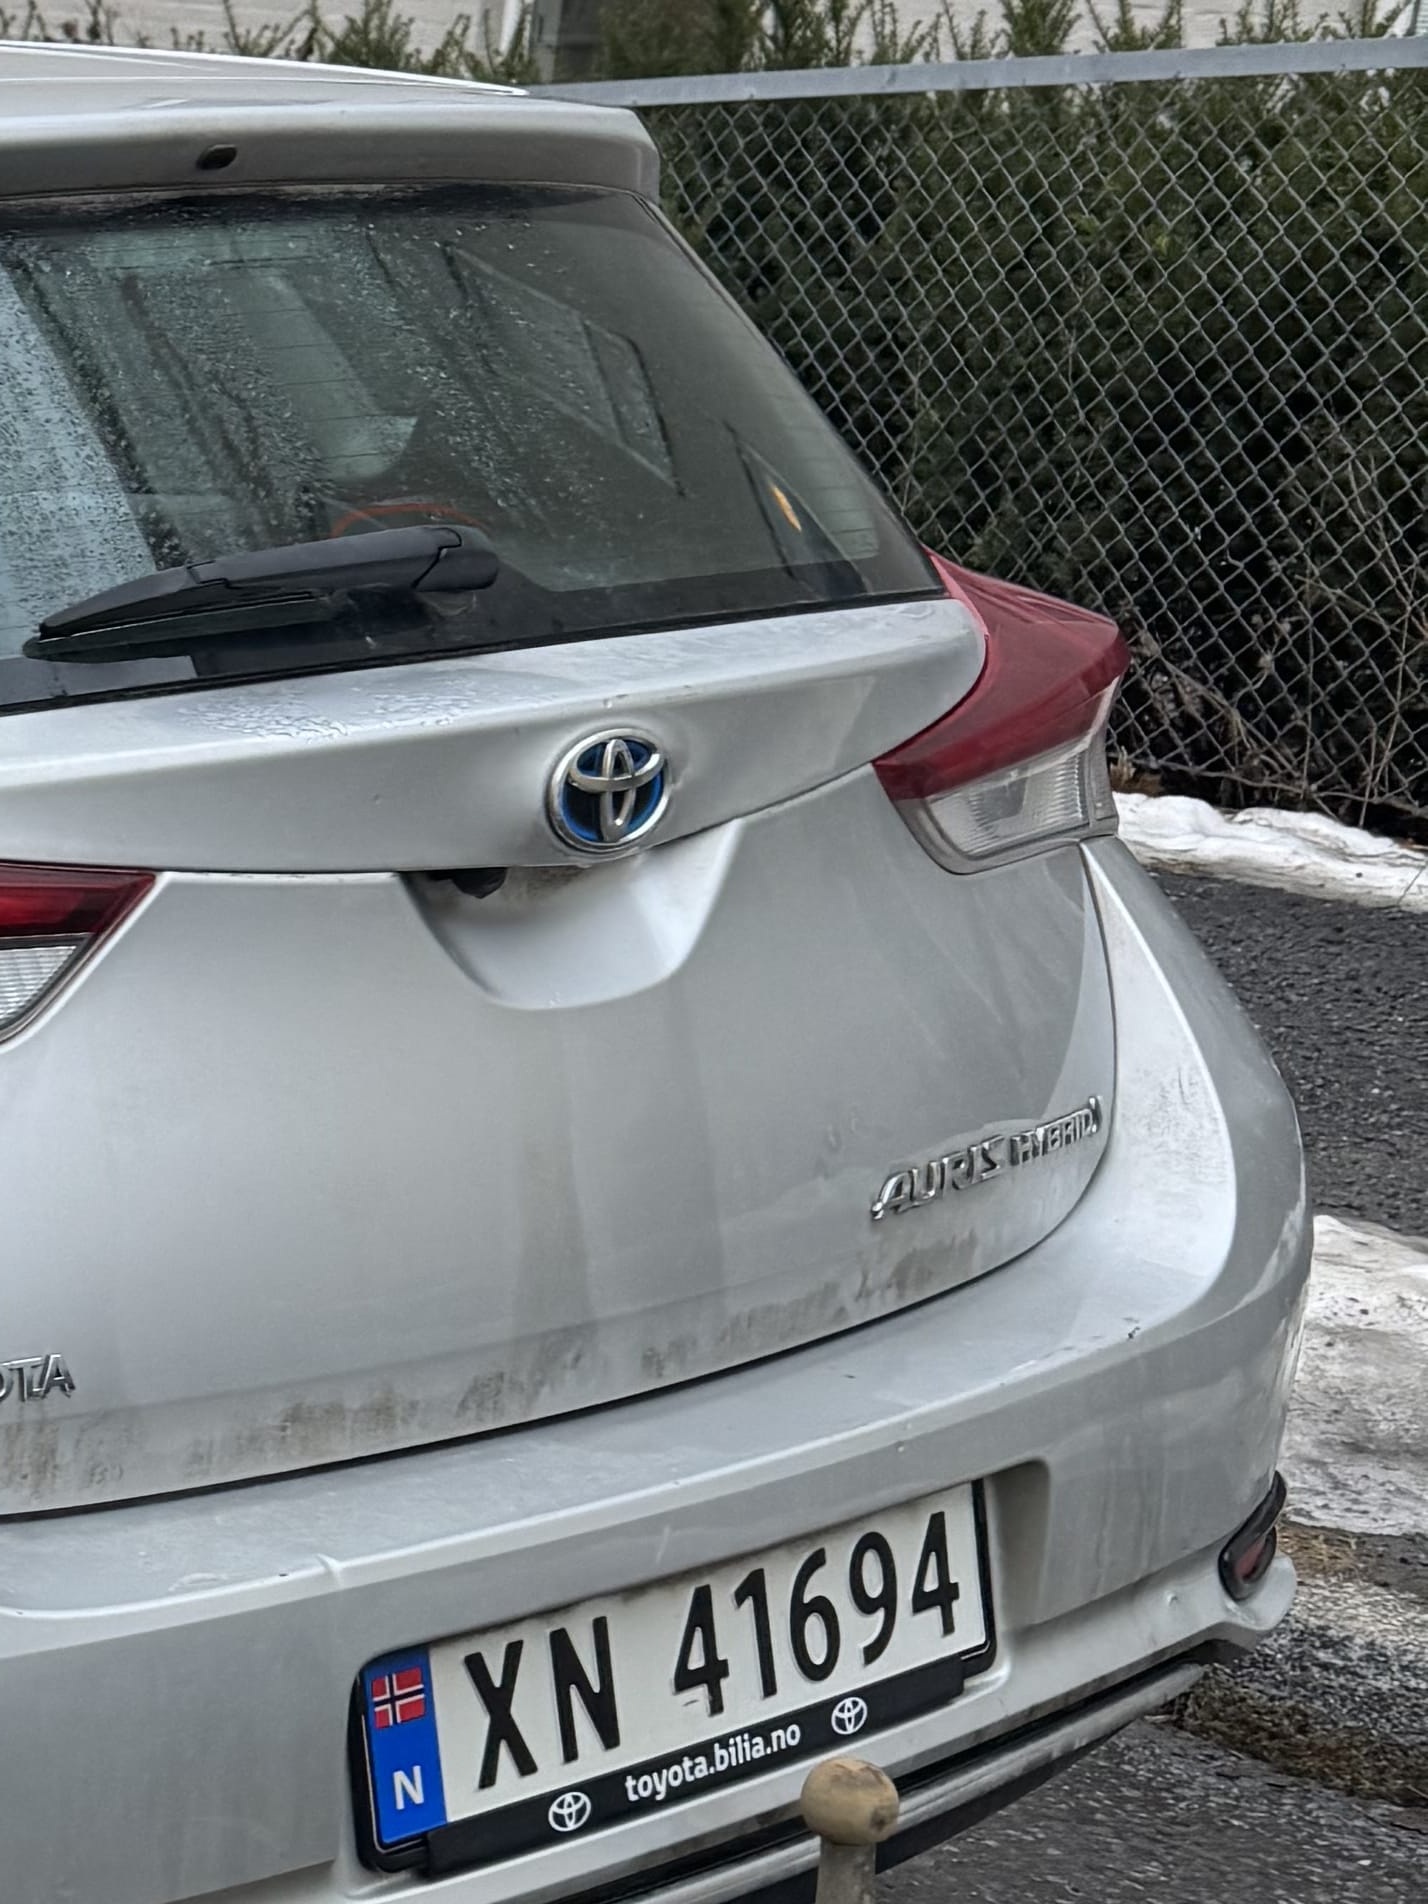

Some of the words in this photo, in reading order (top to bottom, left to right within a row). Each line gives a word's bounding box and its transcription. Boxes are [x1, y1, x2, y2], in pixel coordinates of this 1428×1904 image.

[870, 1134, 1005, 1220] AURIS
[1010, 1096, 1104, 1166] HYBRID
[464, 1616, 620, 1789] XN
[672, 1510, 960, 1717] 41694
[392, 1764, 425, 1811] N
[624, 1721, 802, 1804] toyota.bilia.no
